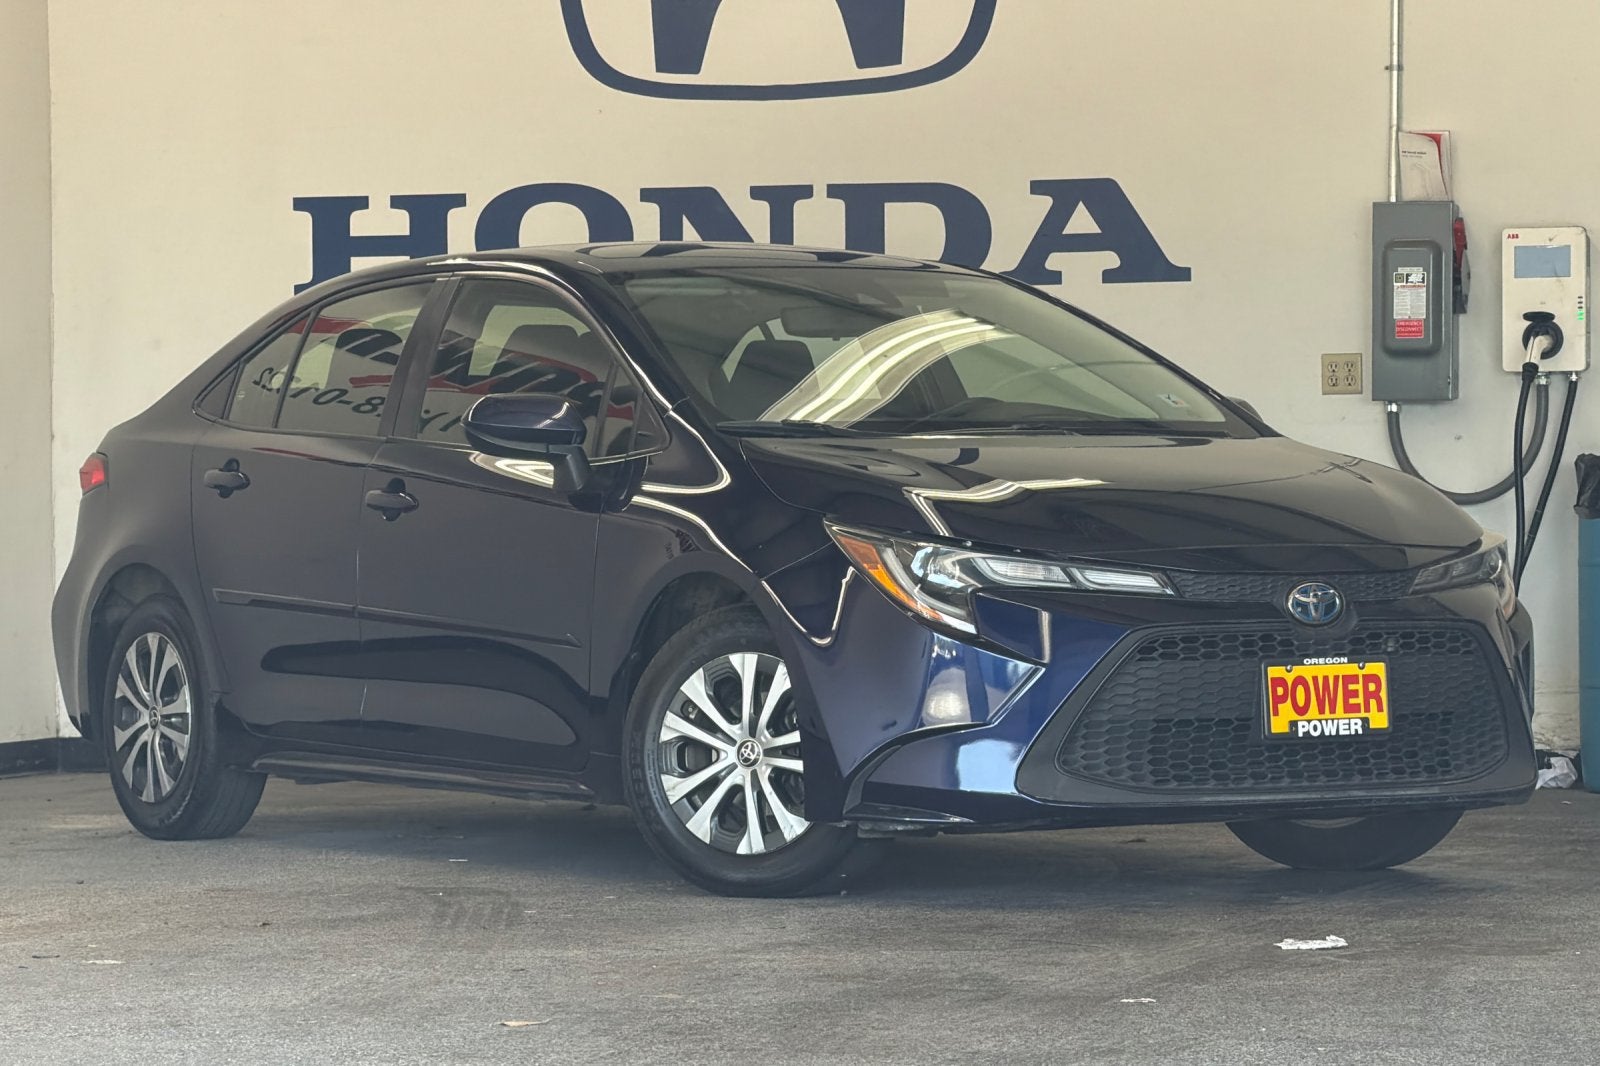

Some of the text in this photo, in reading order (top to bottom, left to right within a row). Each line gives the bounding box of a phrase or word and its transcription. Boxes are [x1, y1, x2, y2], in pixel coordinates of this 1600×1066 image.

[293, 179, 1192, 296] HONDA
[1303, 657, 1348, 665] OREGON
[1270, 674, 1384, 717] POWER
[1298, 718, 1363, 737] POWER
